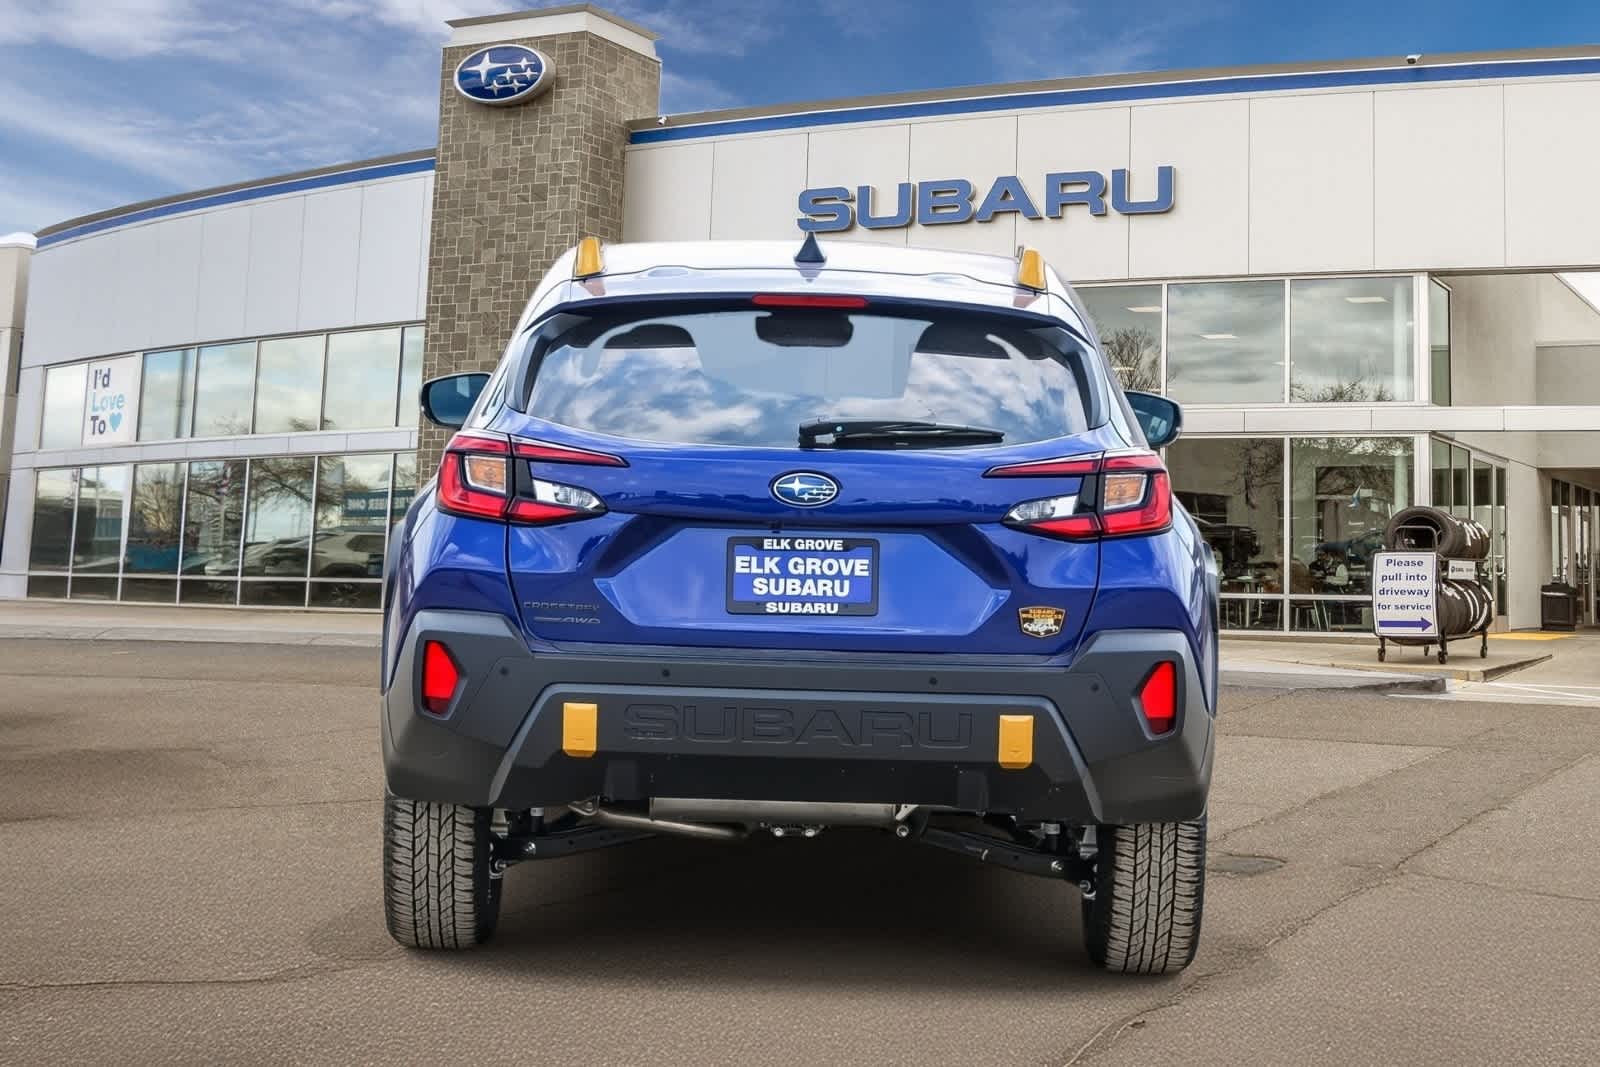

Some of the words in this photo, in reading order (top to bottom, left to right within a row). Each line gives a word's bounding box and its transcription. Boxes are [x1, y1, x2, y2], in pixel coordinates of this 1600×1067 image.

[797, 165, 1176, 233] SUBARU
[94, 368, 111, 389] I'd
[92, 391, 125, 412] Love
[90, 415, 106, 435] To
[763, 539, 791, 550] ELK
[794, 540, 843, 551] GROVE
[735, 556, 781, 575] ELK
[788, 557, 869, 577] GROVE
[1386, 558, 1424, 567] Please
[1381, 573, 1402, 583] pull
[752, 577, 850, 597] SUBARU
[1378, 587, 1430, 597] driveway
[765, 602, 839, 614] SUBARU
[1377, 602, 1391, 610] for
[560, 616, 601, 624] AWD
[624, 703, 974, 749] SUBARU
